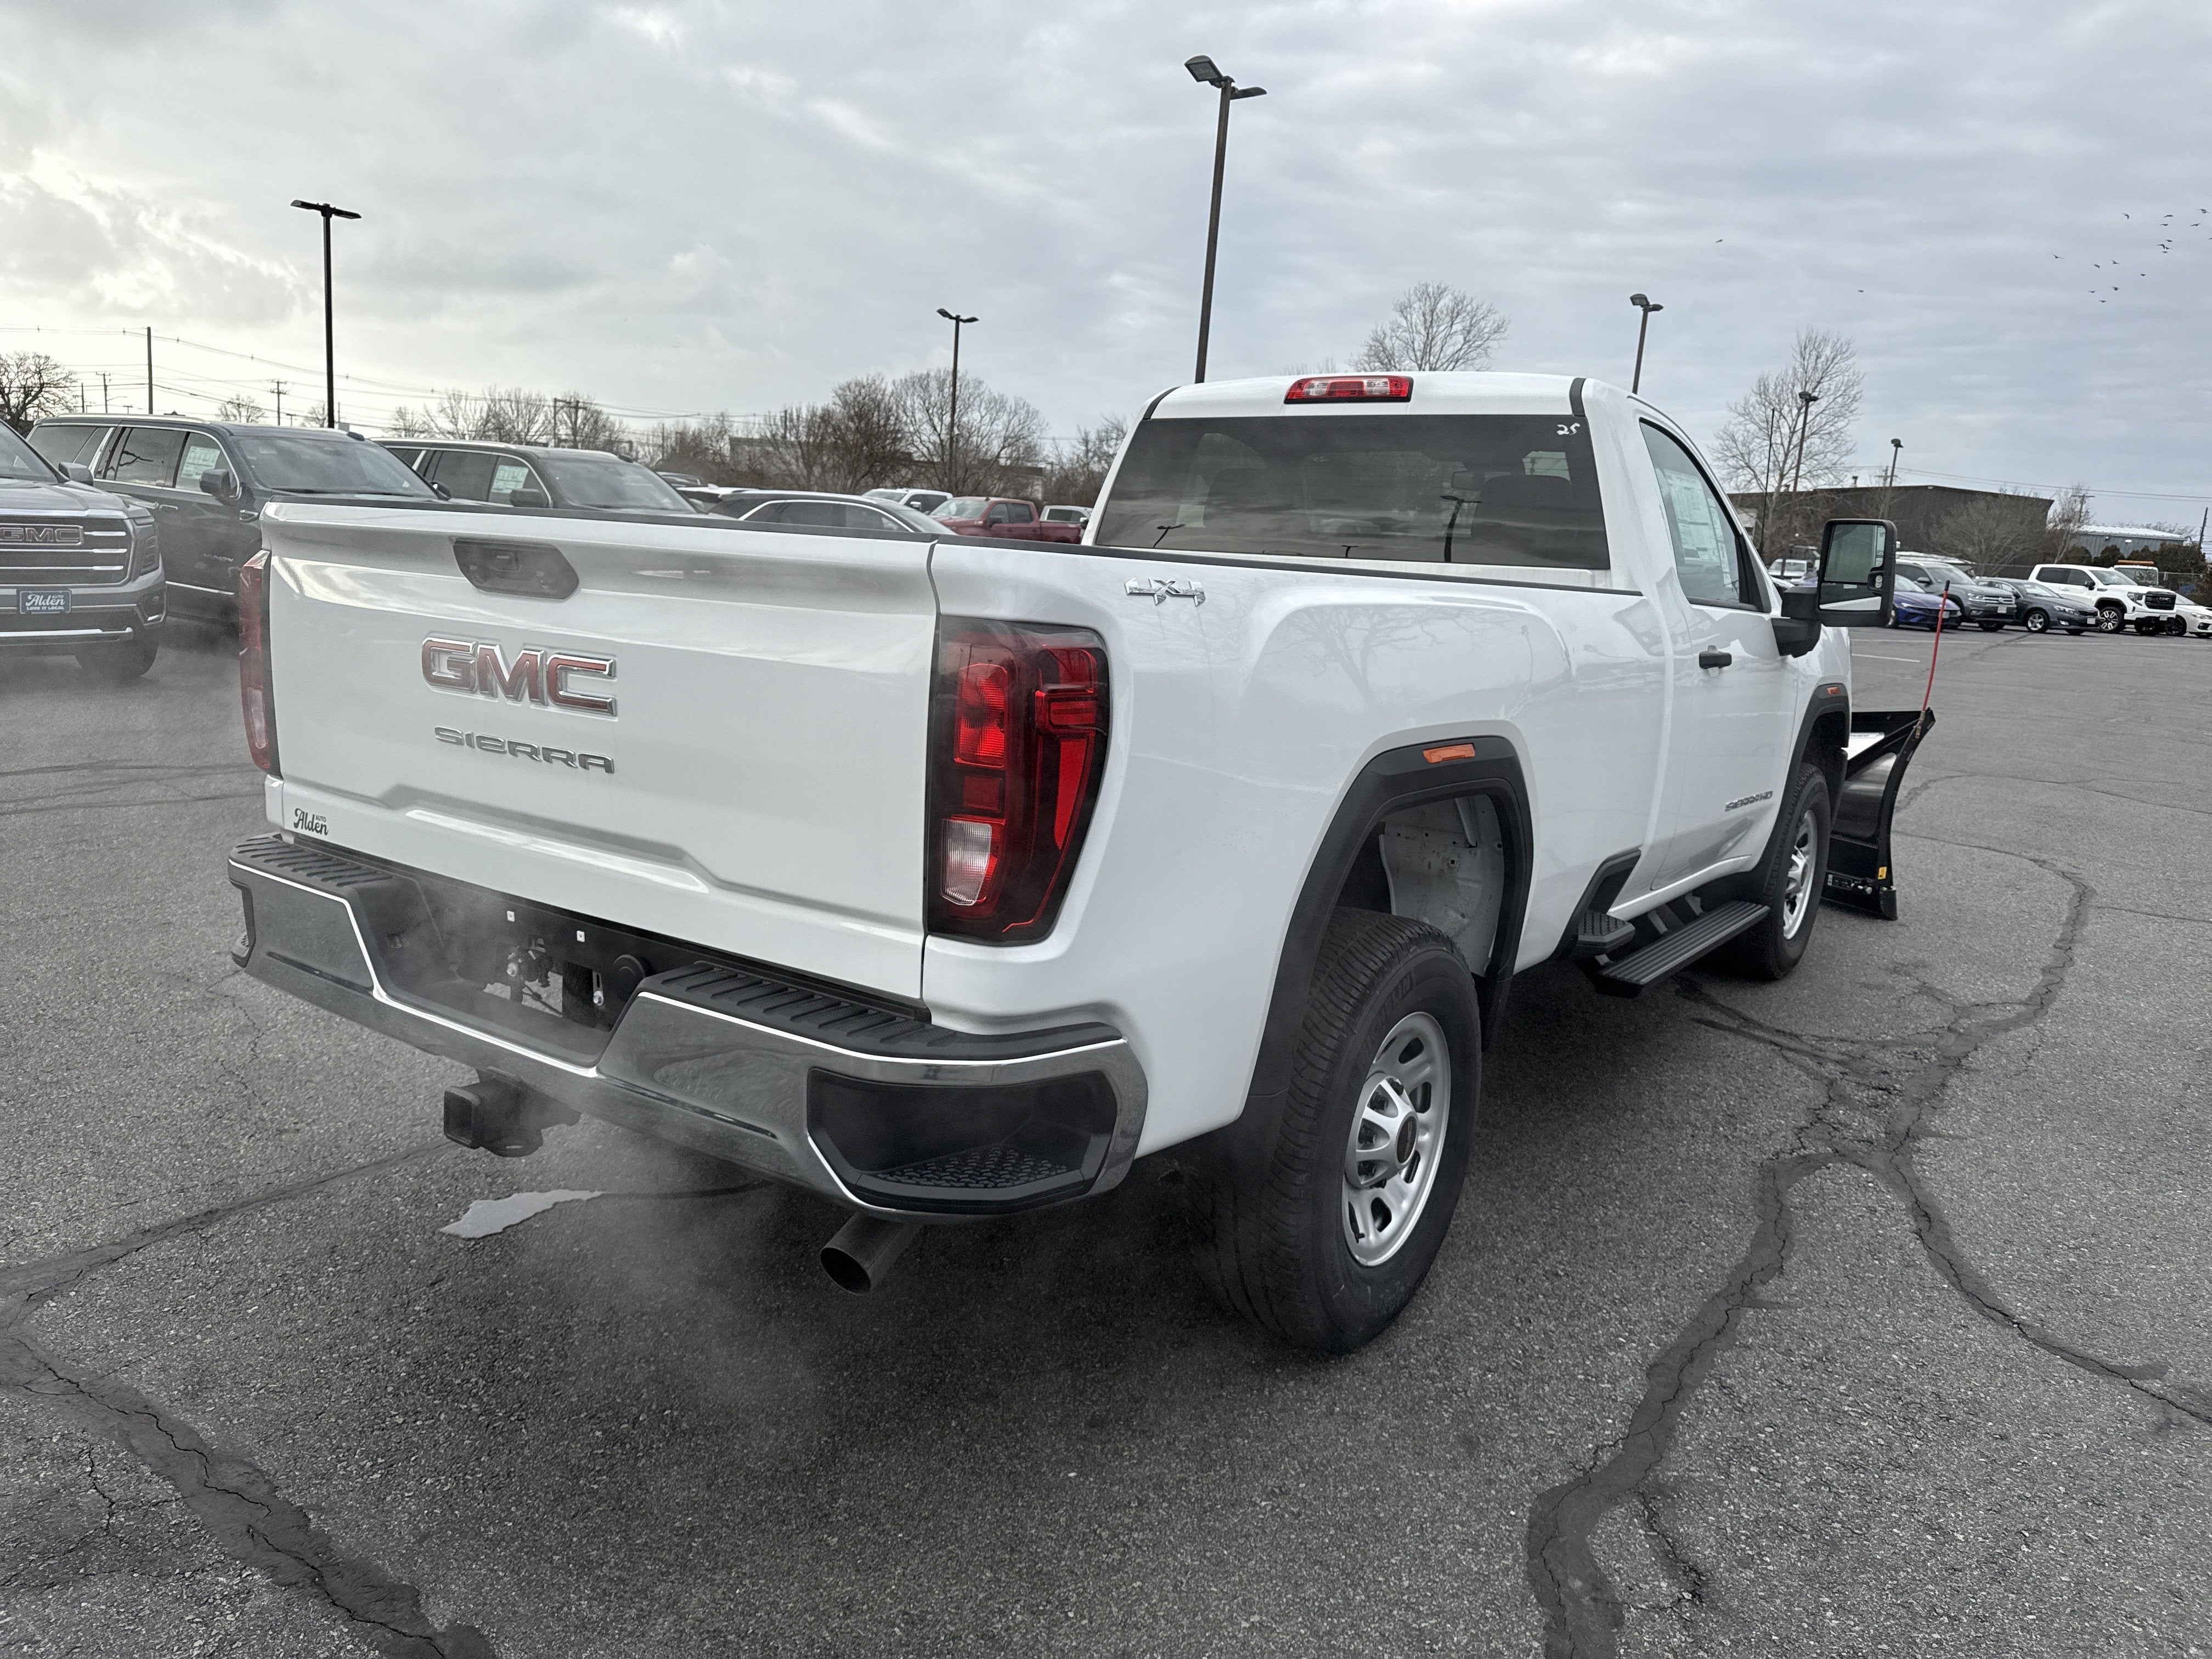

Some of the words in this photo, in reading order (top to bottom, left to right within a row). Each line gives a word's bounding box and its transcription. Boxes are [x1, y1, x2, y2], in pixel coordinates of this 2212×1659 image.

[1556, 422, 1581, 435] 25
[0, 527, 80, 543] GMC
[25, 594, 66, 606] Alden
[421, 636, 619, 716] GMC
[434, 725, 616, 774] SIERRA
[294, 808, 329, 836] Alden
[315, 815, 327, 823] AUTO
